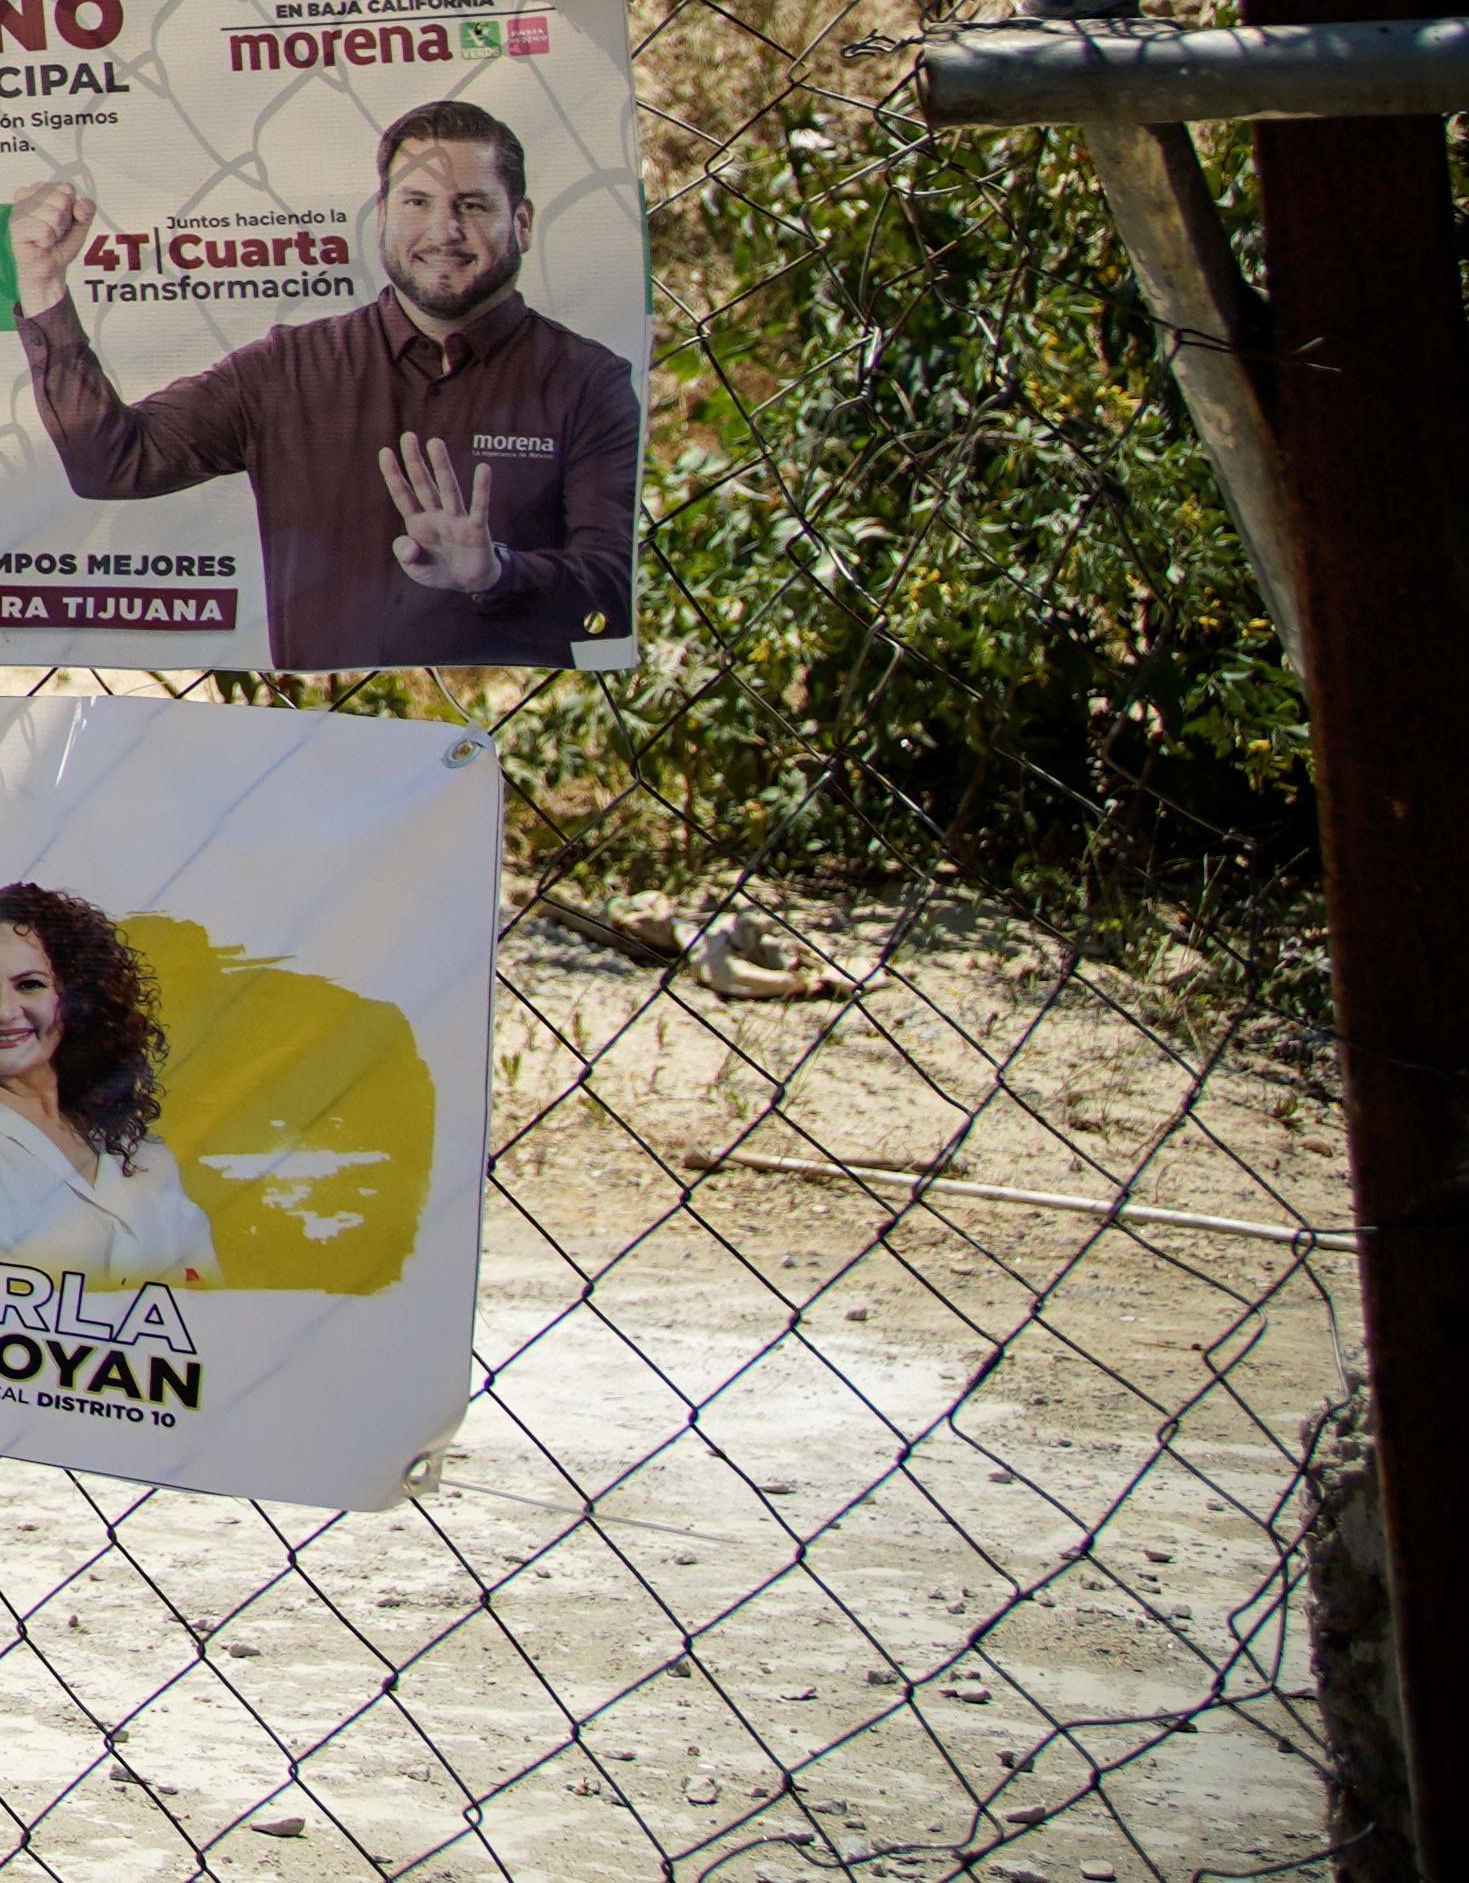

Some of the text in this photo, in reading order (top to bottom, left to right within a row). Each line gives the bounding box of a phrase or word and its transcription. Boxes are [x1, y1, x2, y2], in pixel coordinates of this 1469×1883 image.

[276, 4, 304, 18] EN
[308, 0, 365, 18] BAJA
[231, 25, 453, 71] morena
[31, 111, 118, 129] Sigamos
[167, 209, 347, 231] Juntos haciendo la
[83, 232, 350, 273] 4T Cuarta
[84, 274, 355, 305] Transformación
[473, 435, 554, 451] morena
[87, 555, 236, 577] MEJORES
[62, 597, 222, 621] TIJUANA
[37, 1391, 144, 1423] DISTRITO
[150, 1410, 175, 1428] 10
